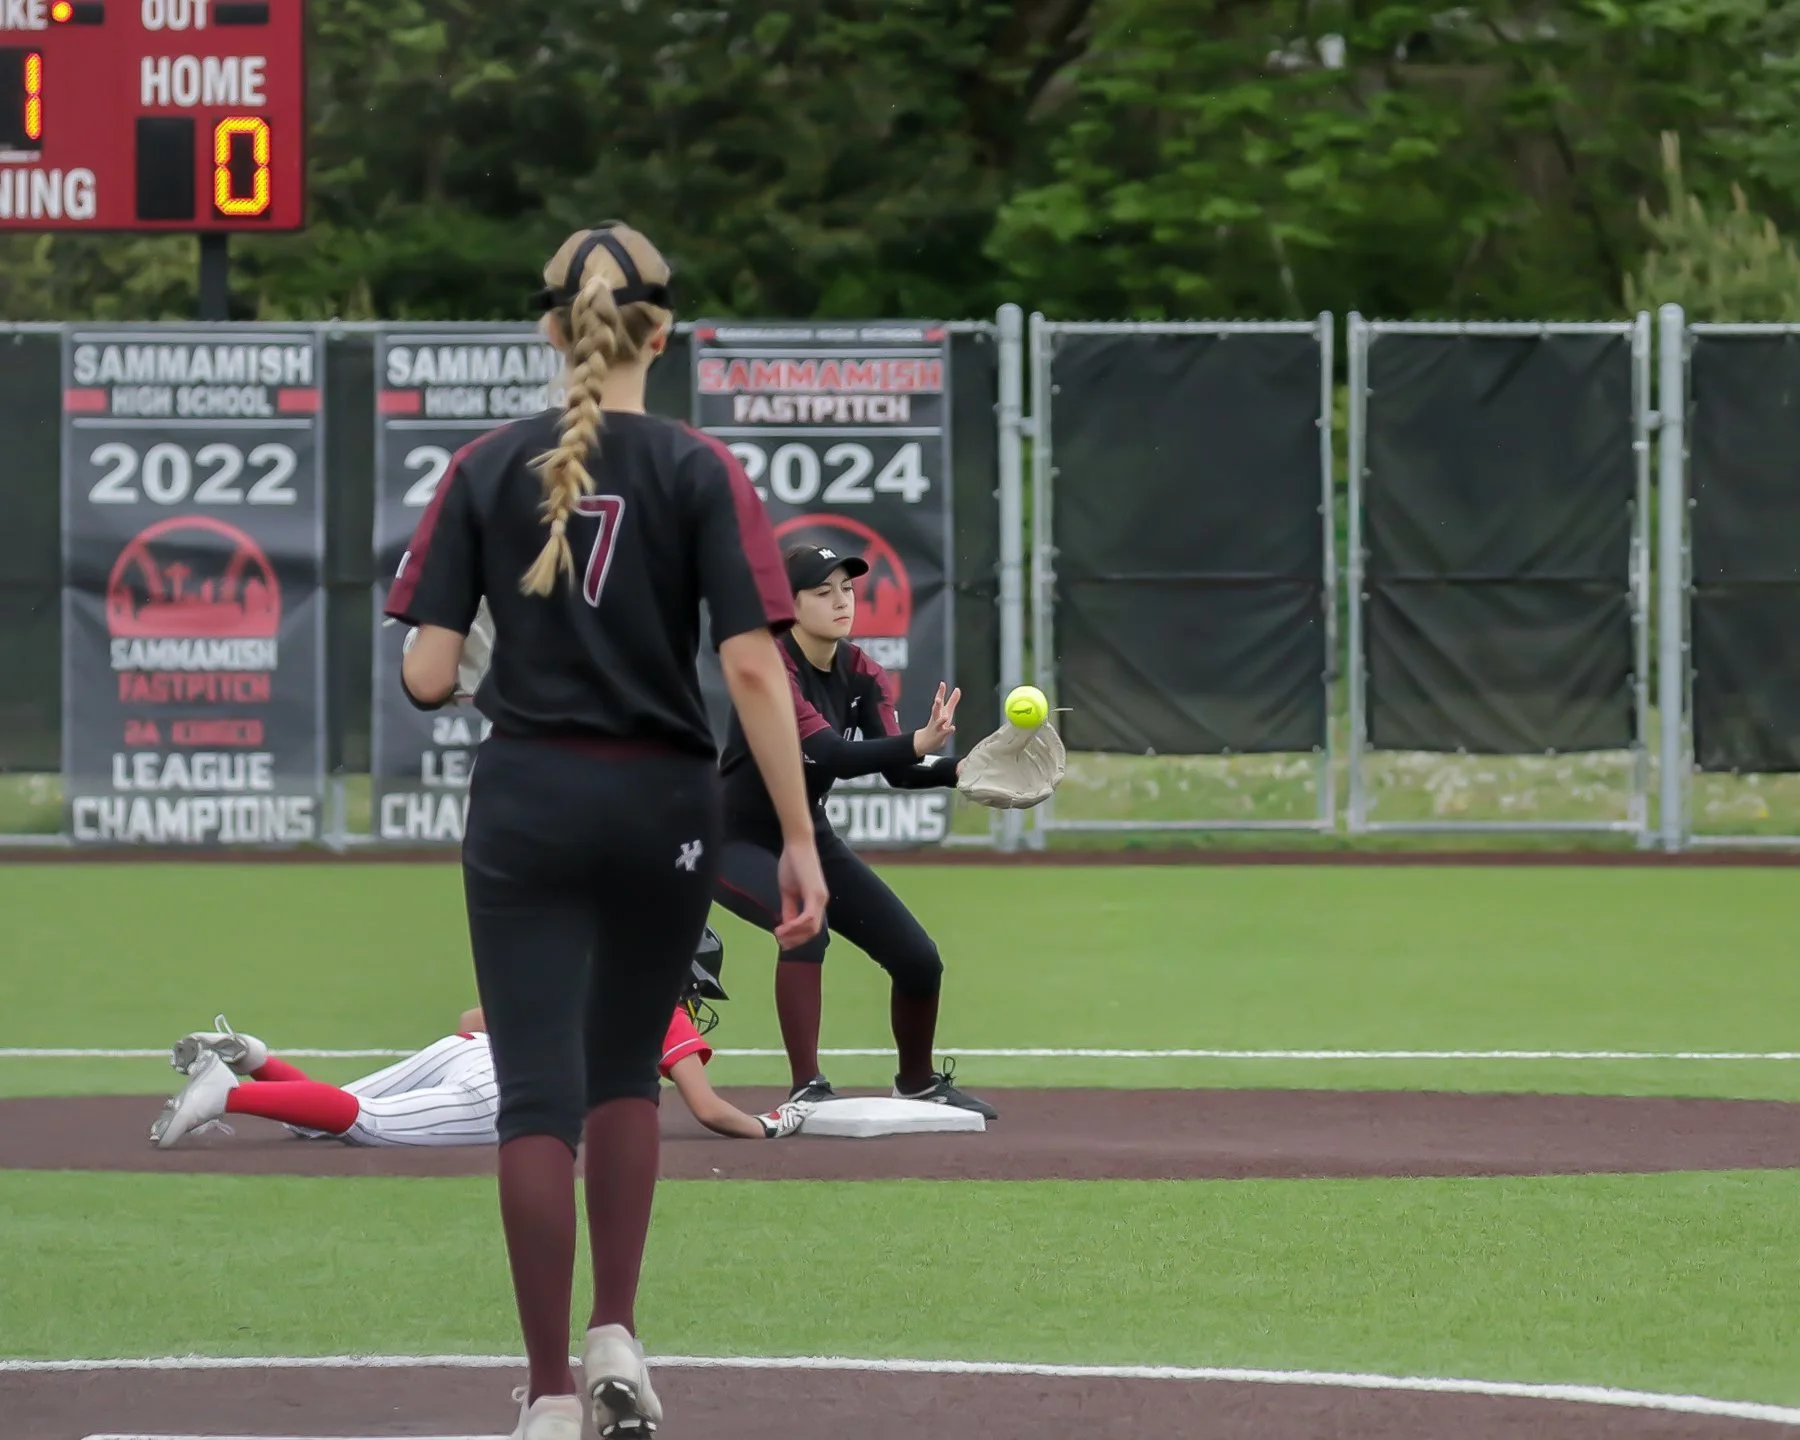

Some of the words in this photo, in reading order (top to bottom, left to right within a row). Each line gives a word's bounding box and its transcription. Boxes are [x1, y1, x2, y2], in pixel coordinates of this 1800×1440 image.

[141, 0, 207, 31] OUT
[25, 53, 41, 139] 1
[141, 55, 267, 107] HOME
[214, 116, 270, 215] 0
[73, 345, 313, 384] SAMMAMISH
[386, 346, 567, 386] SAMMAM
[697, 358, 943, 393] SAMMAMISH
[111, 386, 173, 416] HIGH
[176, 386, 273, 416] SCHOOL
[425, 387, 486, 417] HIGH
[733, 394, 910, 422] FASTPITCH
[88, 442, 297, 505] 2022
[572, 494, 625, 608] 7
[110, 636, 278, 671] SAMMAMISH
[118, 671, 271, 703] FASTPITCH
[111, 752, 276, 791] LEAGUE
[72, 795, 316, 844] CHAMPIONS
